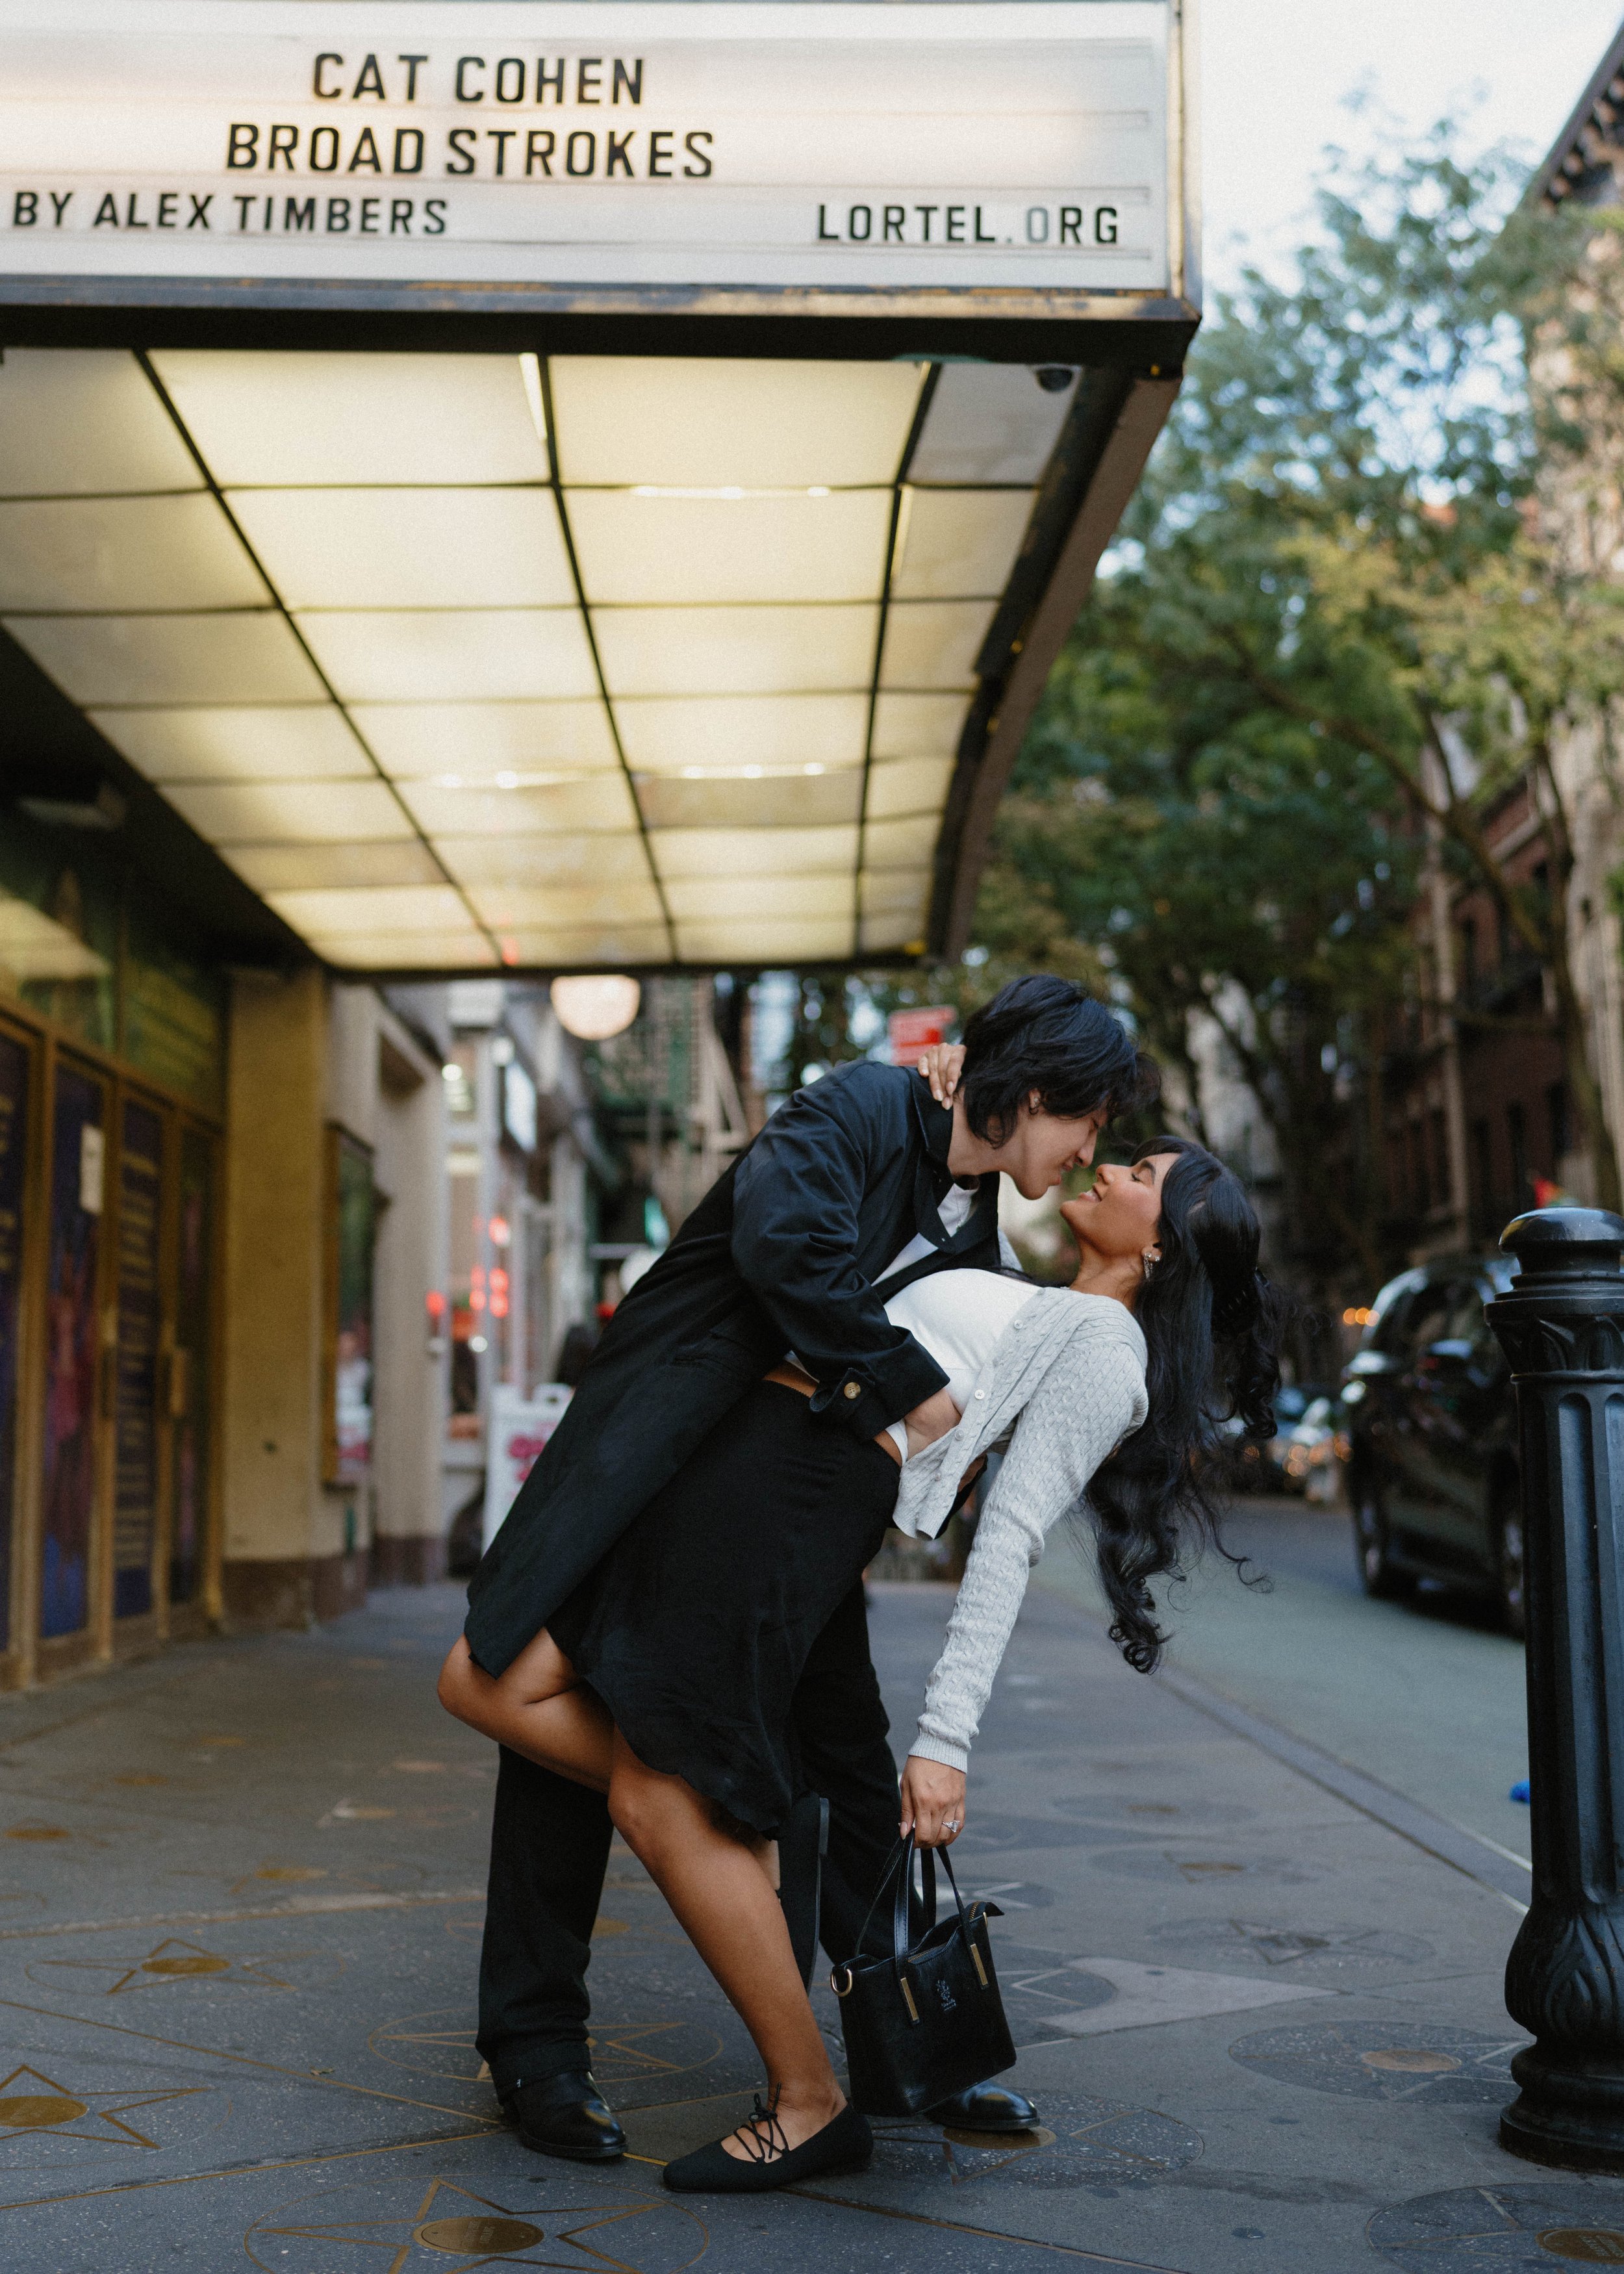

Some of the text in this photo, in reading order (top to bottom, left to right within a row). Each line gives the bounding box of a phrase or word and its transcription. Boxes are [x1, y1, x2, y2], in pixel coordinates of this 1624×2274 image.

[312, 52, 644, 105] CAT COHEN
[226, 123, 713, 179] BROAD STROKES
[12, 190, 448, 235] BY ALEX TIMBERS
[817, 204, 1119, 245] LORTEL.ORG
